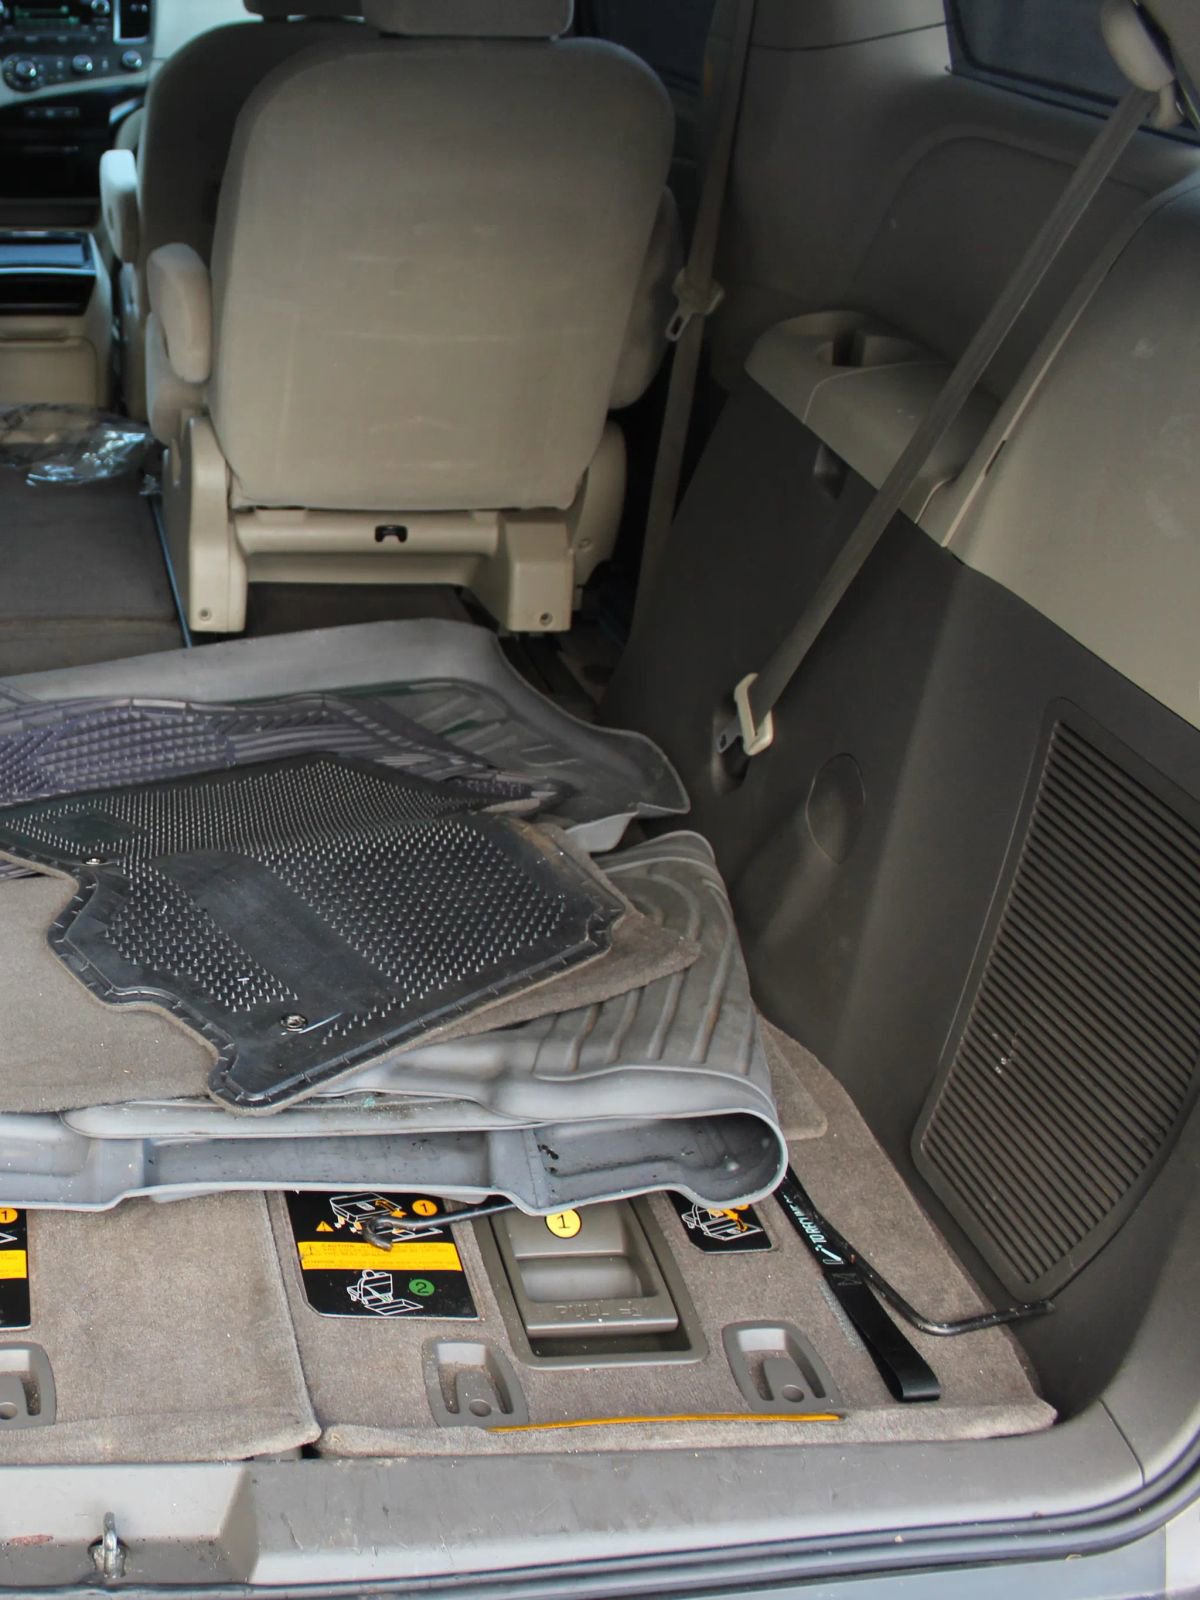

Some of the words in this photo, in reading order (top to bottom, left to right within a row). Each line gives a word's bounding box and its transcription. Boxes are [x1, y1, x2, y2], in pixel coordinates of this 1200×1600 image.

[556, 1214, 571, 1229] 1
[809, 1233, 827, 1244] TO
[415, 1281, 429, 1294] 2
